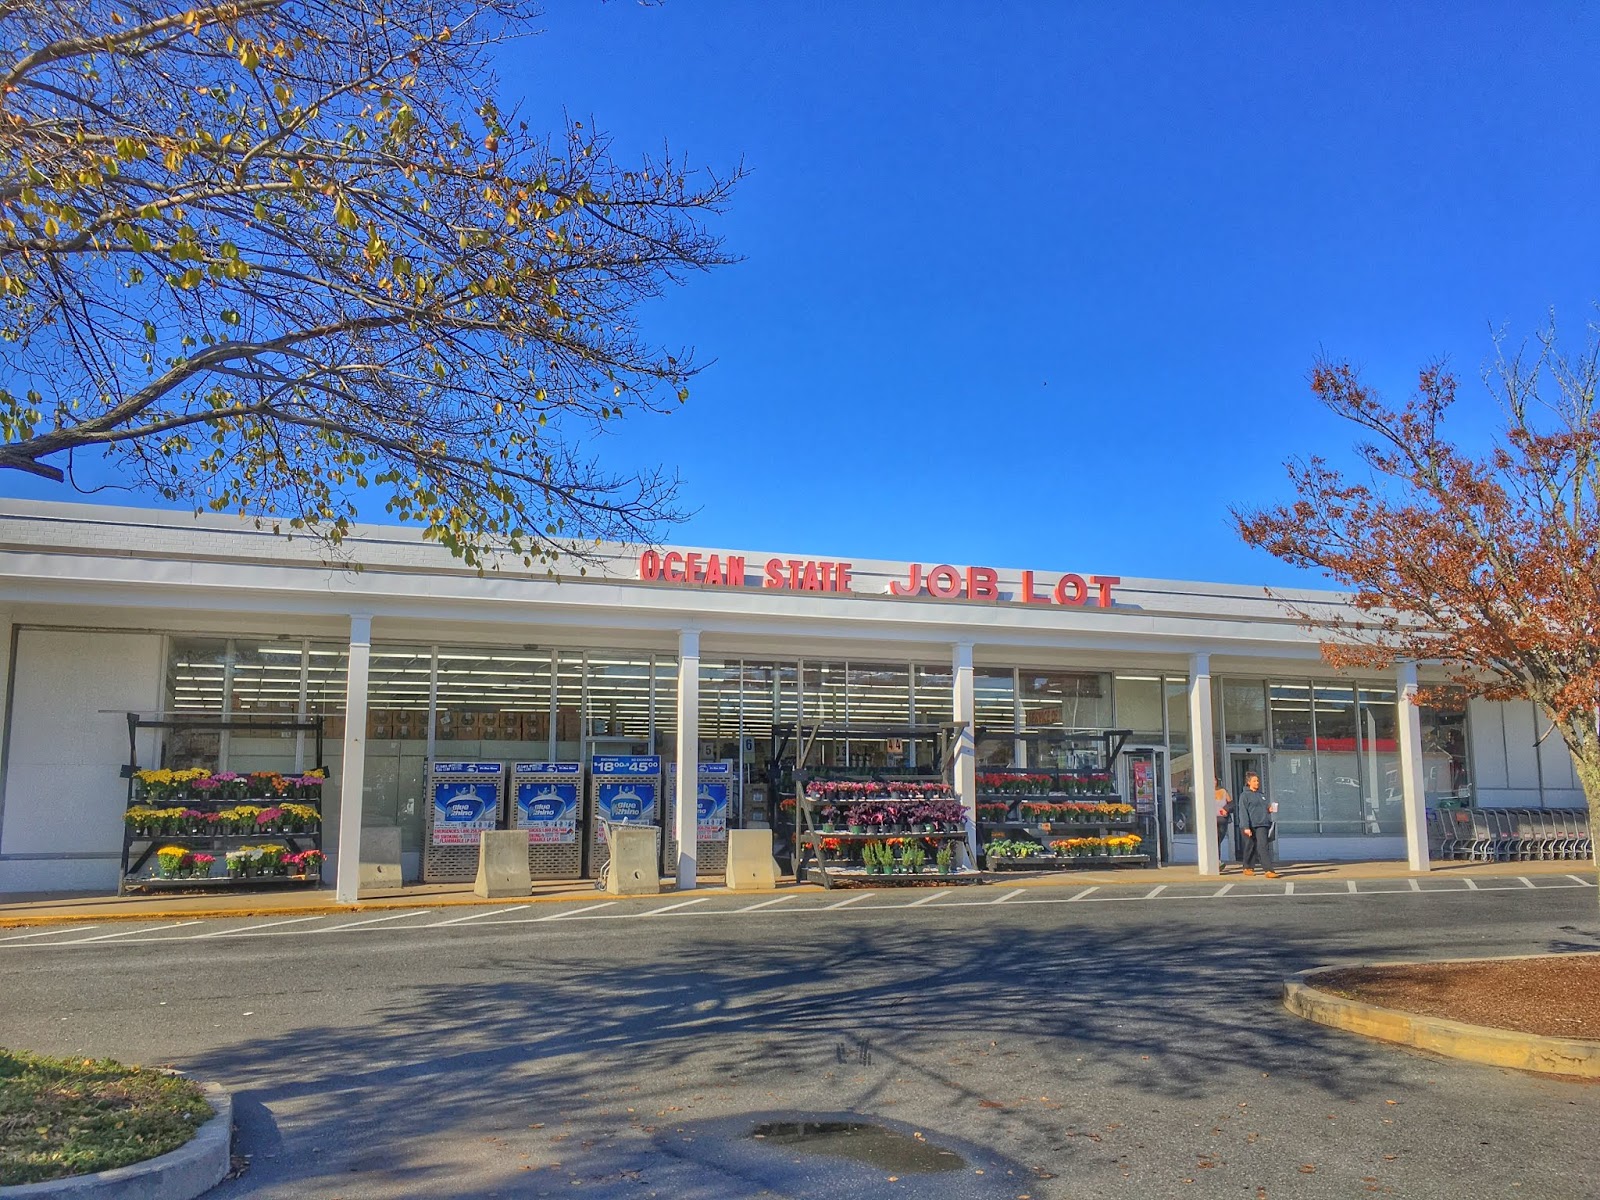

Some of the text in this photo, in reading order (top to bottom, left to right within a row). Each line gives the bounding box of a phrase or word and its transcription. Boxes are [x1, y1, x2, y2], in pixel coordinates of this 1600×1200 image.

[640, 550, 1121, 608] OCEAN STATE JOB LOT
[705, 745, 712, 756] 5
[745, 739, 753, 751] 6
